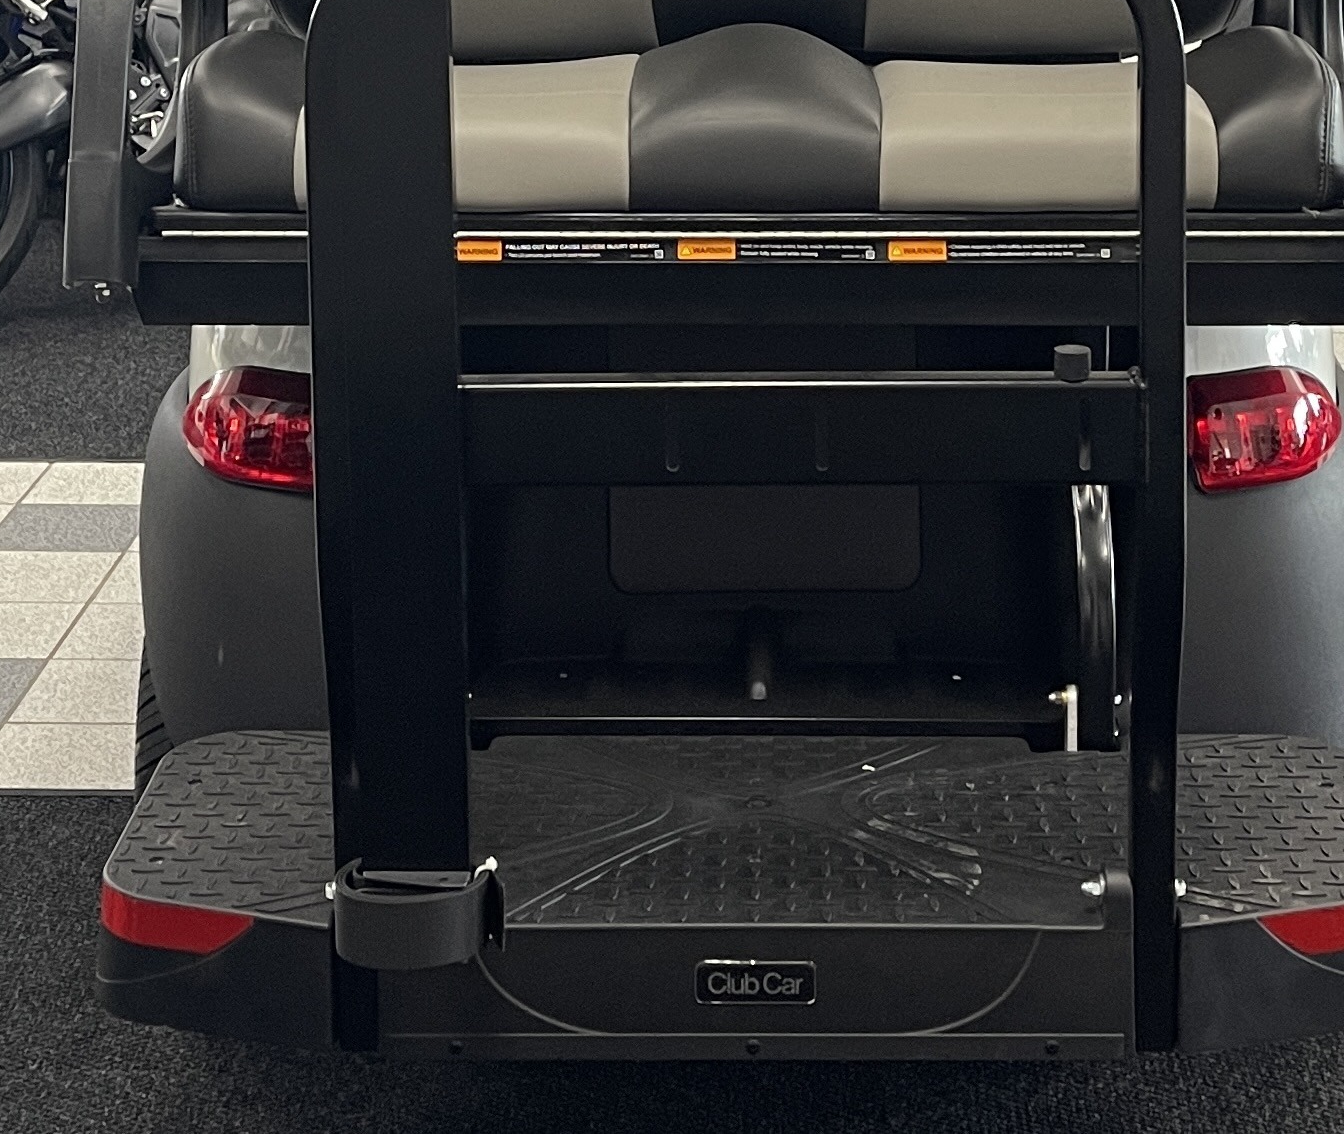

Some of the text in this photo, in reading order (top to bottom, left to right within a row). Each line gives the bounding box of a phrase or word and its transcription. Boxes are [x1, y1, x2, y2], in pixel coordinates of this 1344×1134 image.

[459, 247, 499, 256] WARNING
[691, 247, 732, 255] WARNING
[903, 247, 944, 255] WARNING
[707, 971, 804, 995] Club Car
